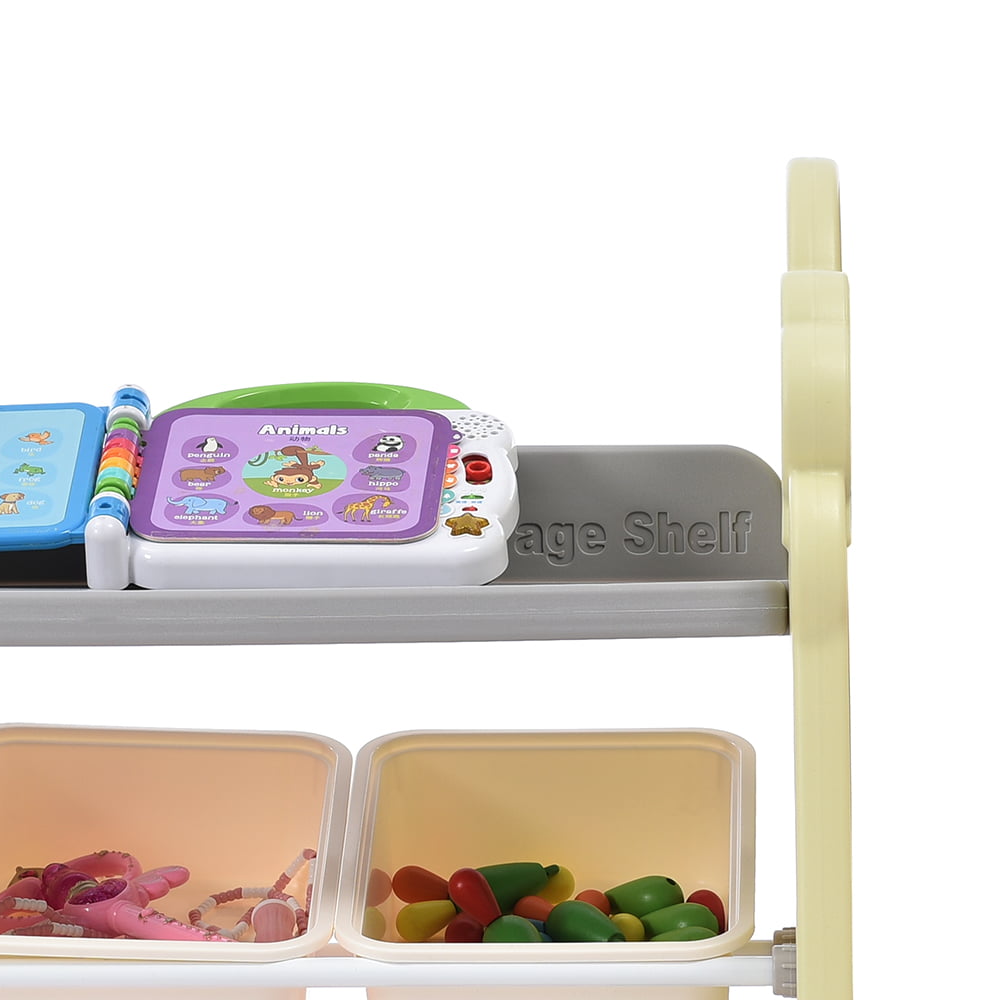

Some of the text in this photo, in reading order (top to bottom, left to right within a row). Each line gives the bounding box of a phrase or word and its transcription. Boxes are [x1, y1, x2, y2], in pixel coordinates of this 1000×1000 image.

[257, 424, 349, 436] Animals
[514, 511, 753, 567] age Shelf
